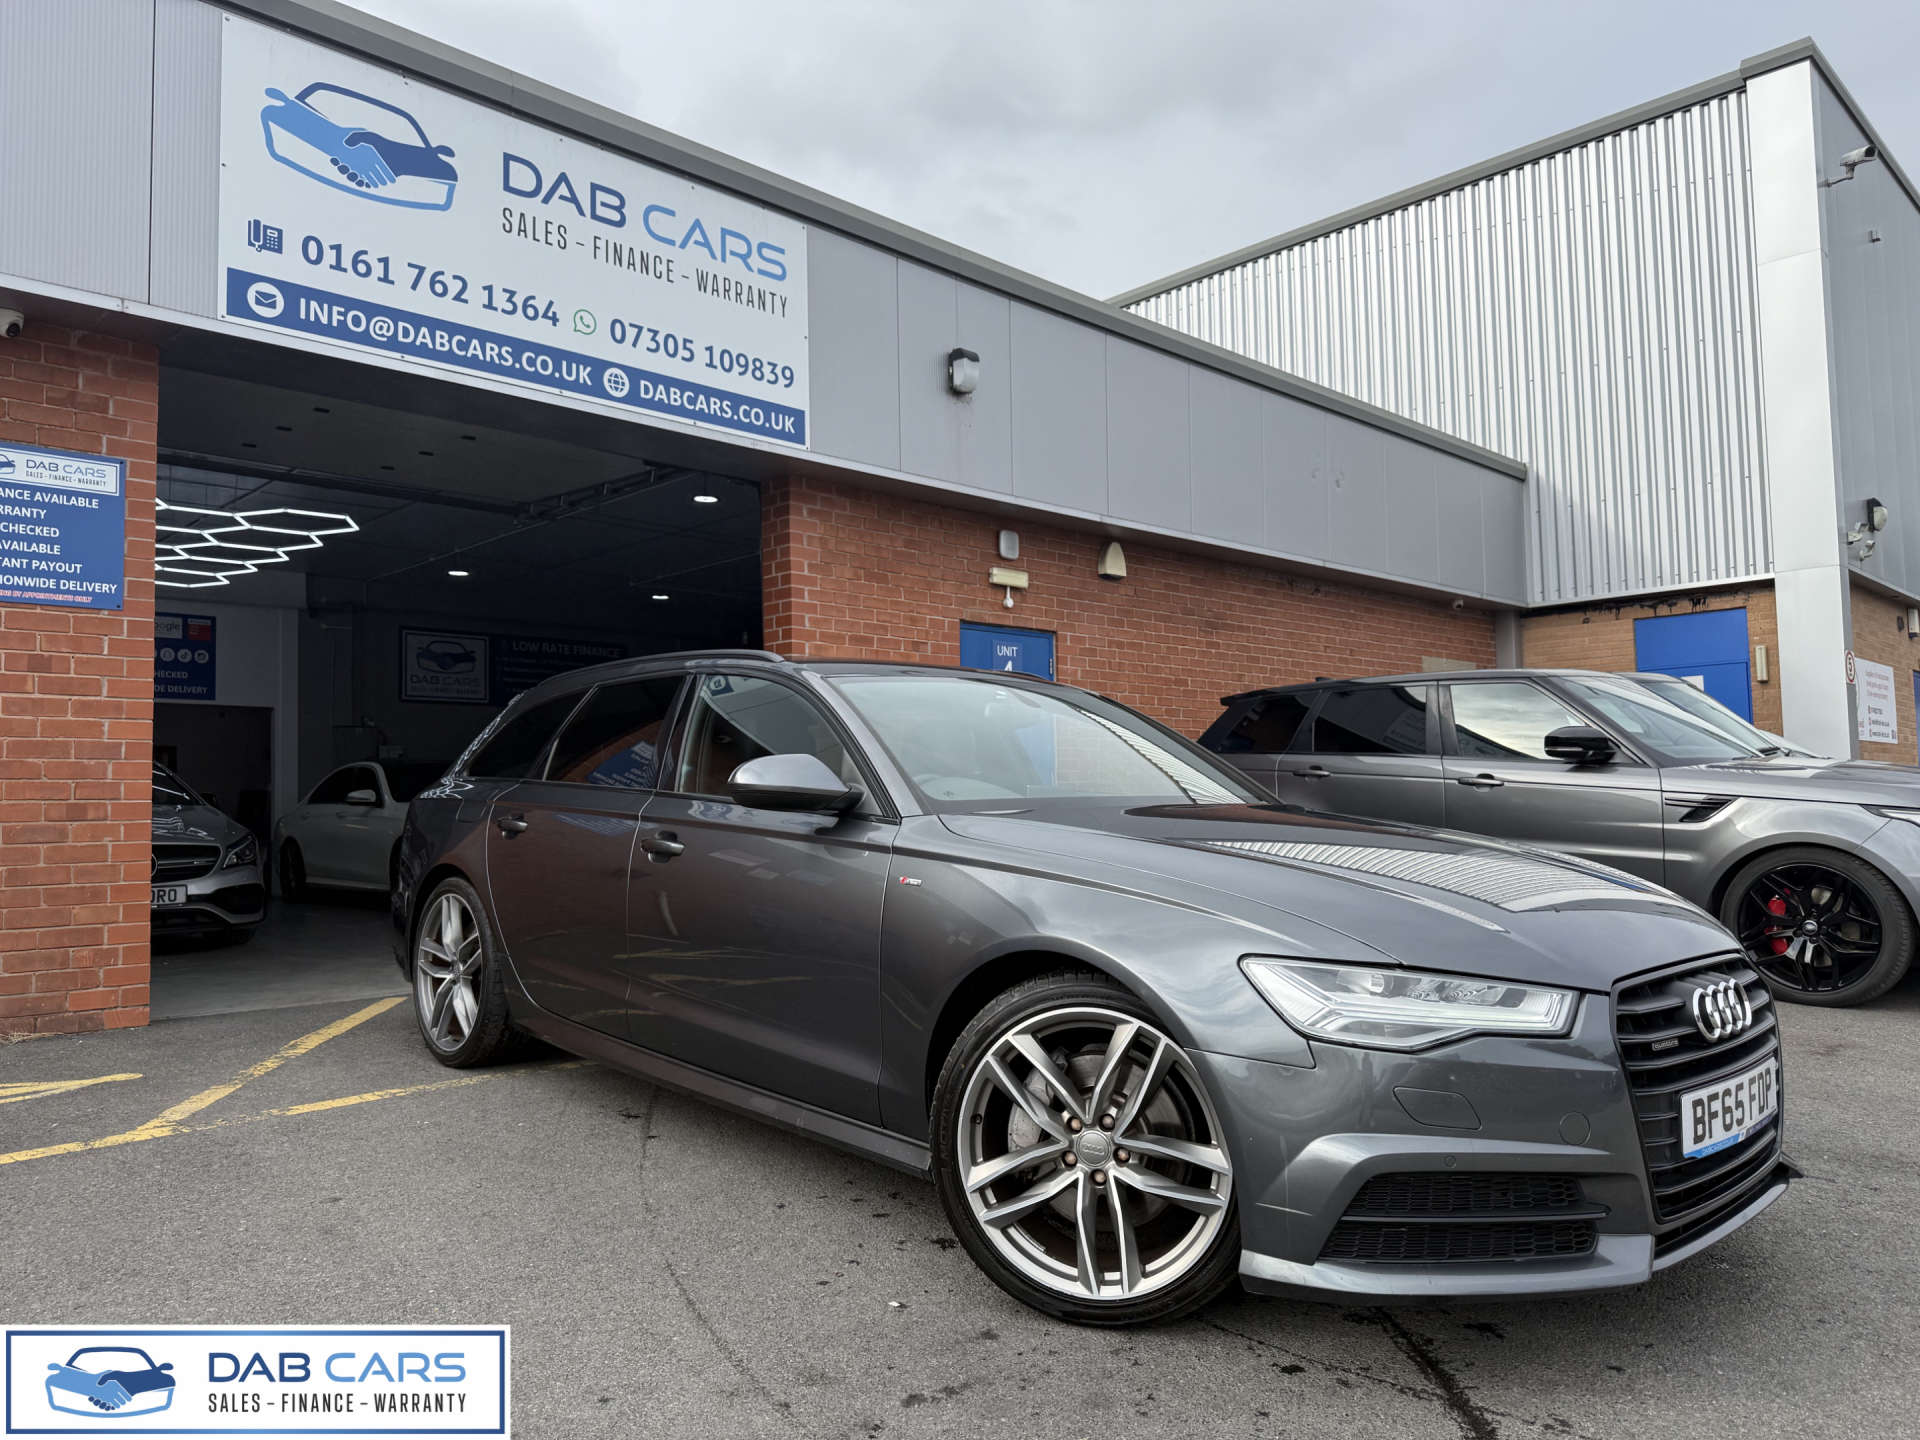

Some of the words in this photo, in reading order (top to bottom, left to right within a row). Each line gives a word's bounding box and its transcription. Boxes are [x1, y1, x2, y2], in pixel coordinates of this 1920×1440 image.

[503, 152, 626, 228] DAB
[642, 204, 787, 281] CARS
[301, 235, 395, 285] 0161
[407, 262, 469, 304] 762
[481, 284, 559, 327] 1364
[502, 207, 567, 249] SALES
[593, 236, 674, 283] FINANCE
[696, 268, 787, 318] WARRANTY
[300, 298, 592, 386] INFO@DABCARS.CO.UK
[610, 318, 695, 363] 07305
[704, 345, 794, 388] 109839
[640, 380, 796, 434] DABCARS.CO.UK
[26, 459, 59, 472] DAB
[63, 464, 106, 479] CARS
[34, 491, 99, 509] AVAILABLE
[0, 521, 60, 538] CHECKED
[0, 540, 61, 555] VAILABLE
[32, 559, 82, 574] PAYOUT
[60, 579, 117, 594] DELIVERY
[997, 645, 1018, 657] UNIT
[1692, 1083, 1745, 1145] BF65
[1749, 1067, 1772, 1120] FDP
